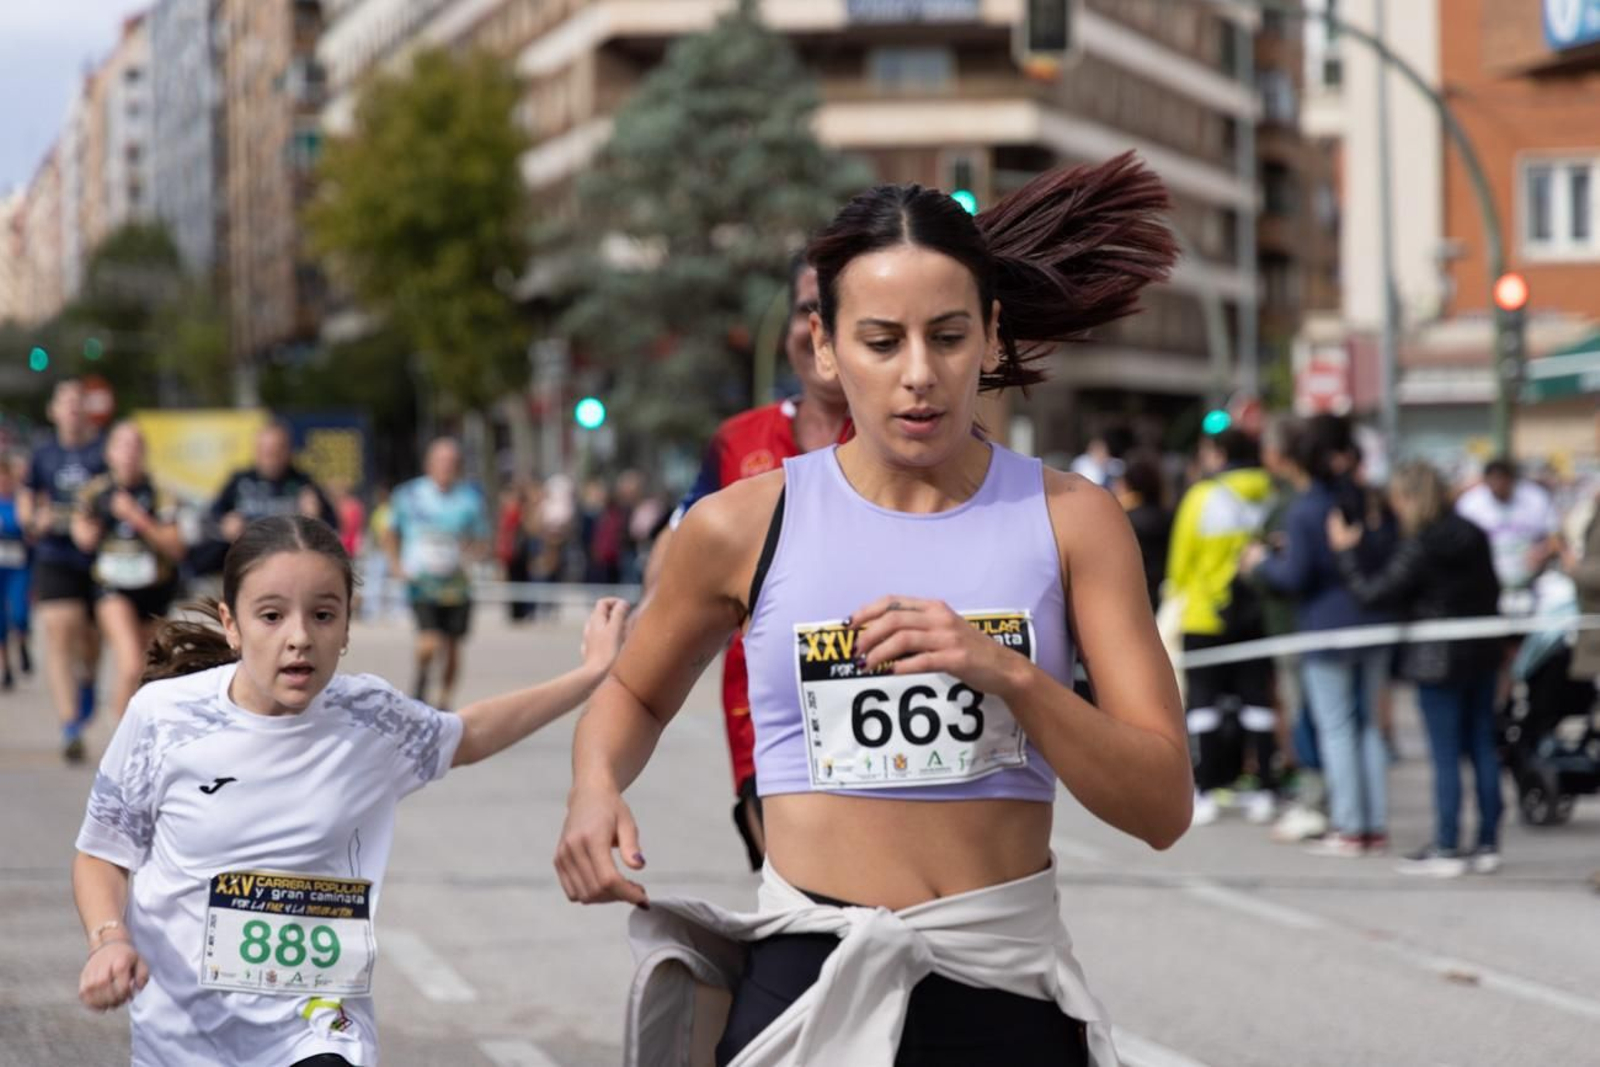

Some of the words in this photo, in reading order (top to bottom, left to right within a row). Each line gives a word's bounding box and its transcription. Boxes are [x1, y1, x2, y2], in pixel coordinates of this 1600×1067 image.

[806, 629, 854, 662] XXV
[851, 683, 985, 748] 663
[215, 873, 254, 897] XXV
[255, 876, 312, 891] CARRERA
[314, 881, 365, 894] POPULAR
[271, 888, 304, 900] gran
[310, 891, 365, 904] caminata
[239, 919, 341, 969] 889
